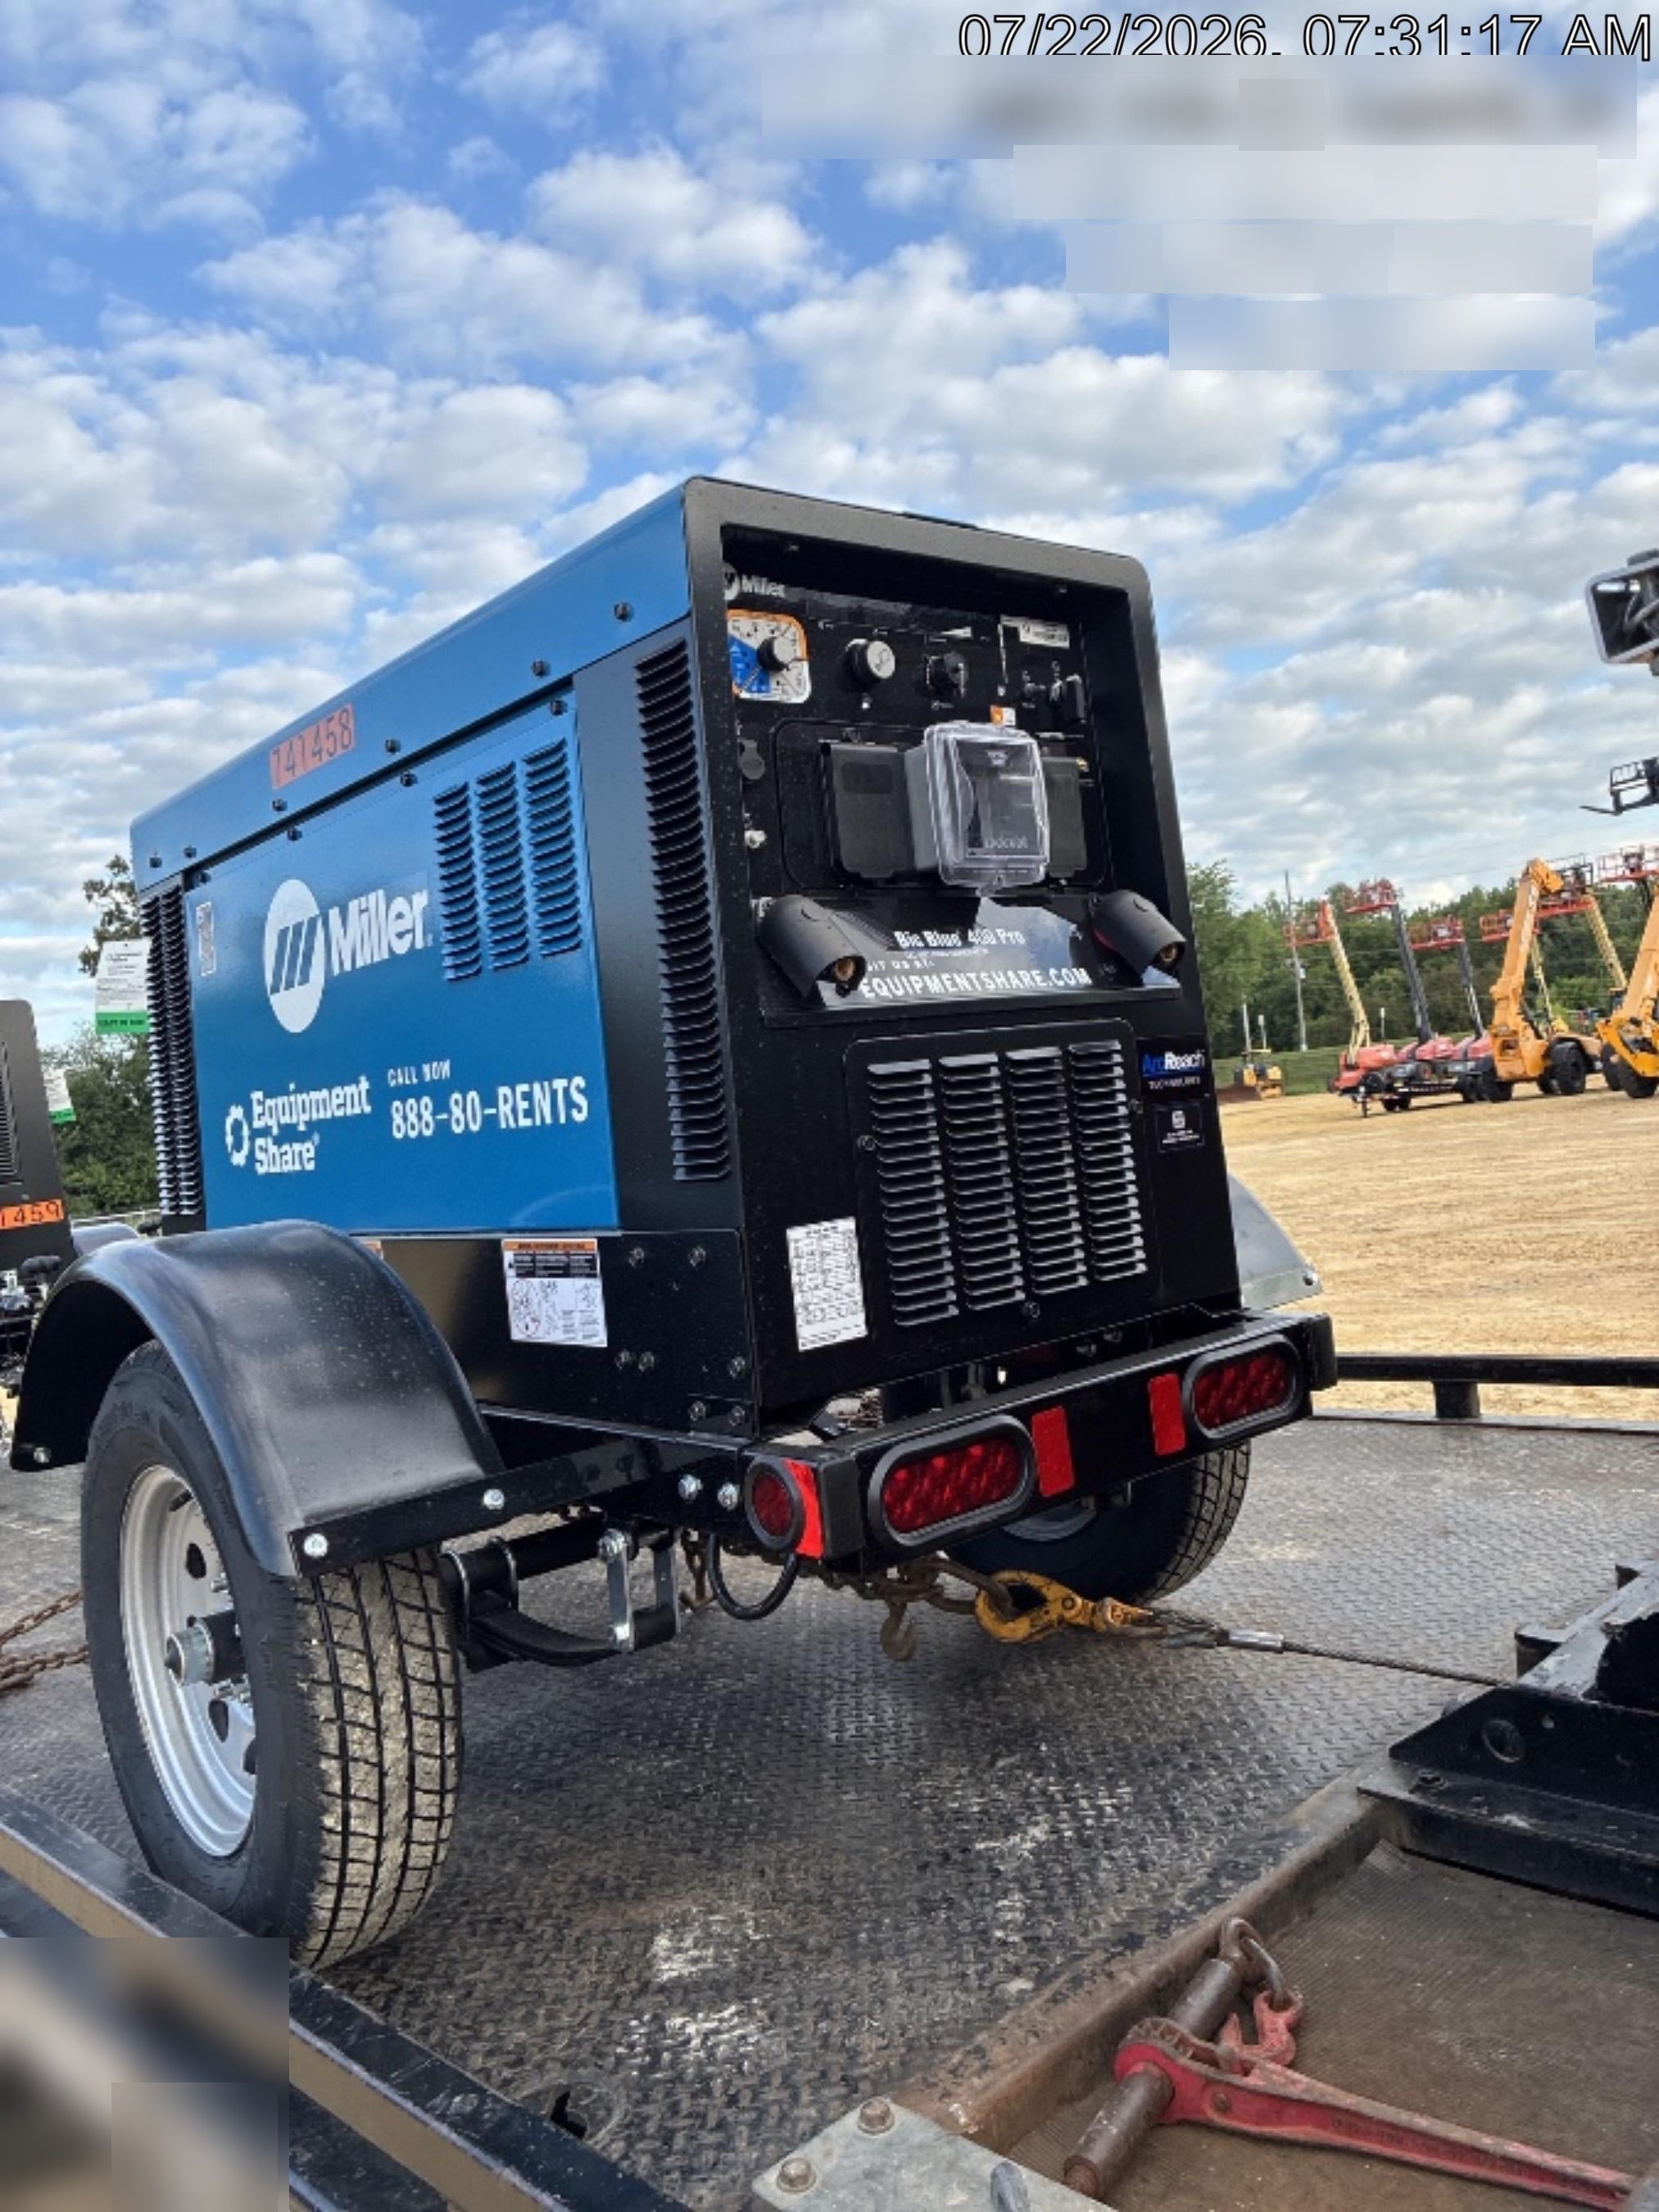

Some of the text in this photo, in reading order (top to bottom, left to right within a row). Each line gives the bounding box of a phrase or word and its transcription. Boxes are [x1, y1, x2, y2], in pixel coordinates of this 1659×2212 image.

[272, 707, 352, 784] 741458
[329, 889, 428, 977] Miller
[859, 968, 1092, 999] EQUIPMENTSHARE.COM
[388, 1059, 451, 1087] CALL NOW
[250, 1075, 372, 1135] Equipment
[391, 1076, 588, 1139] 888-80-RENTS
[255, 1135, 316, 1175] Share
